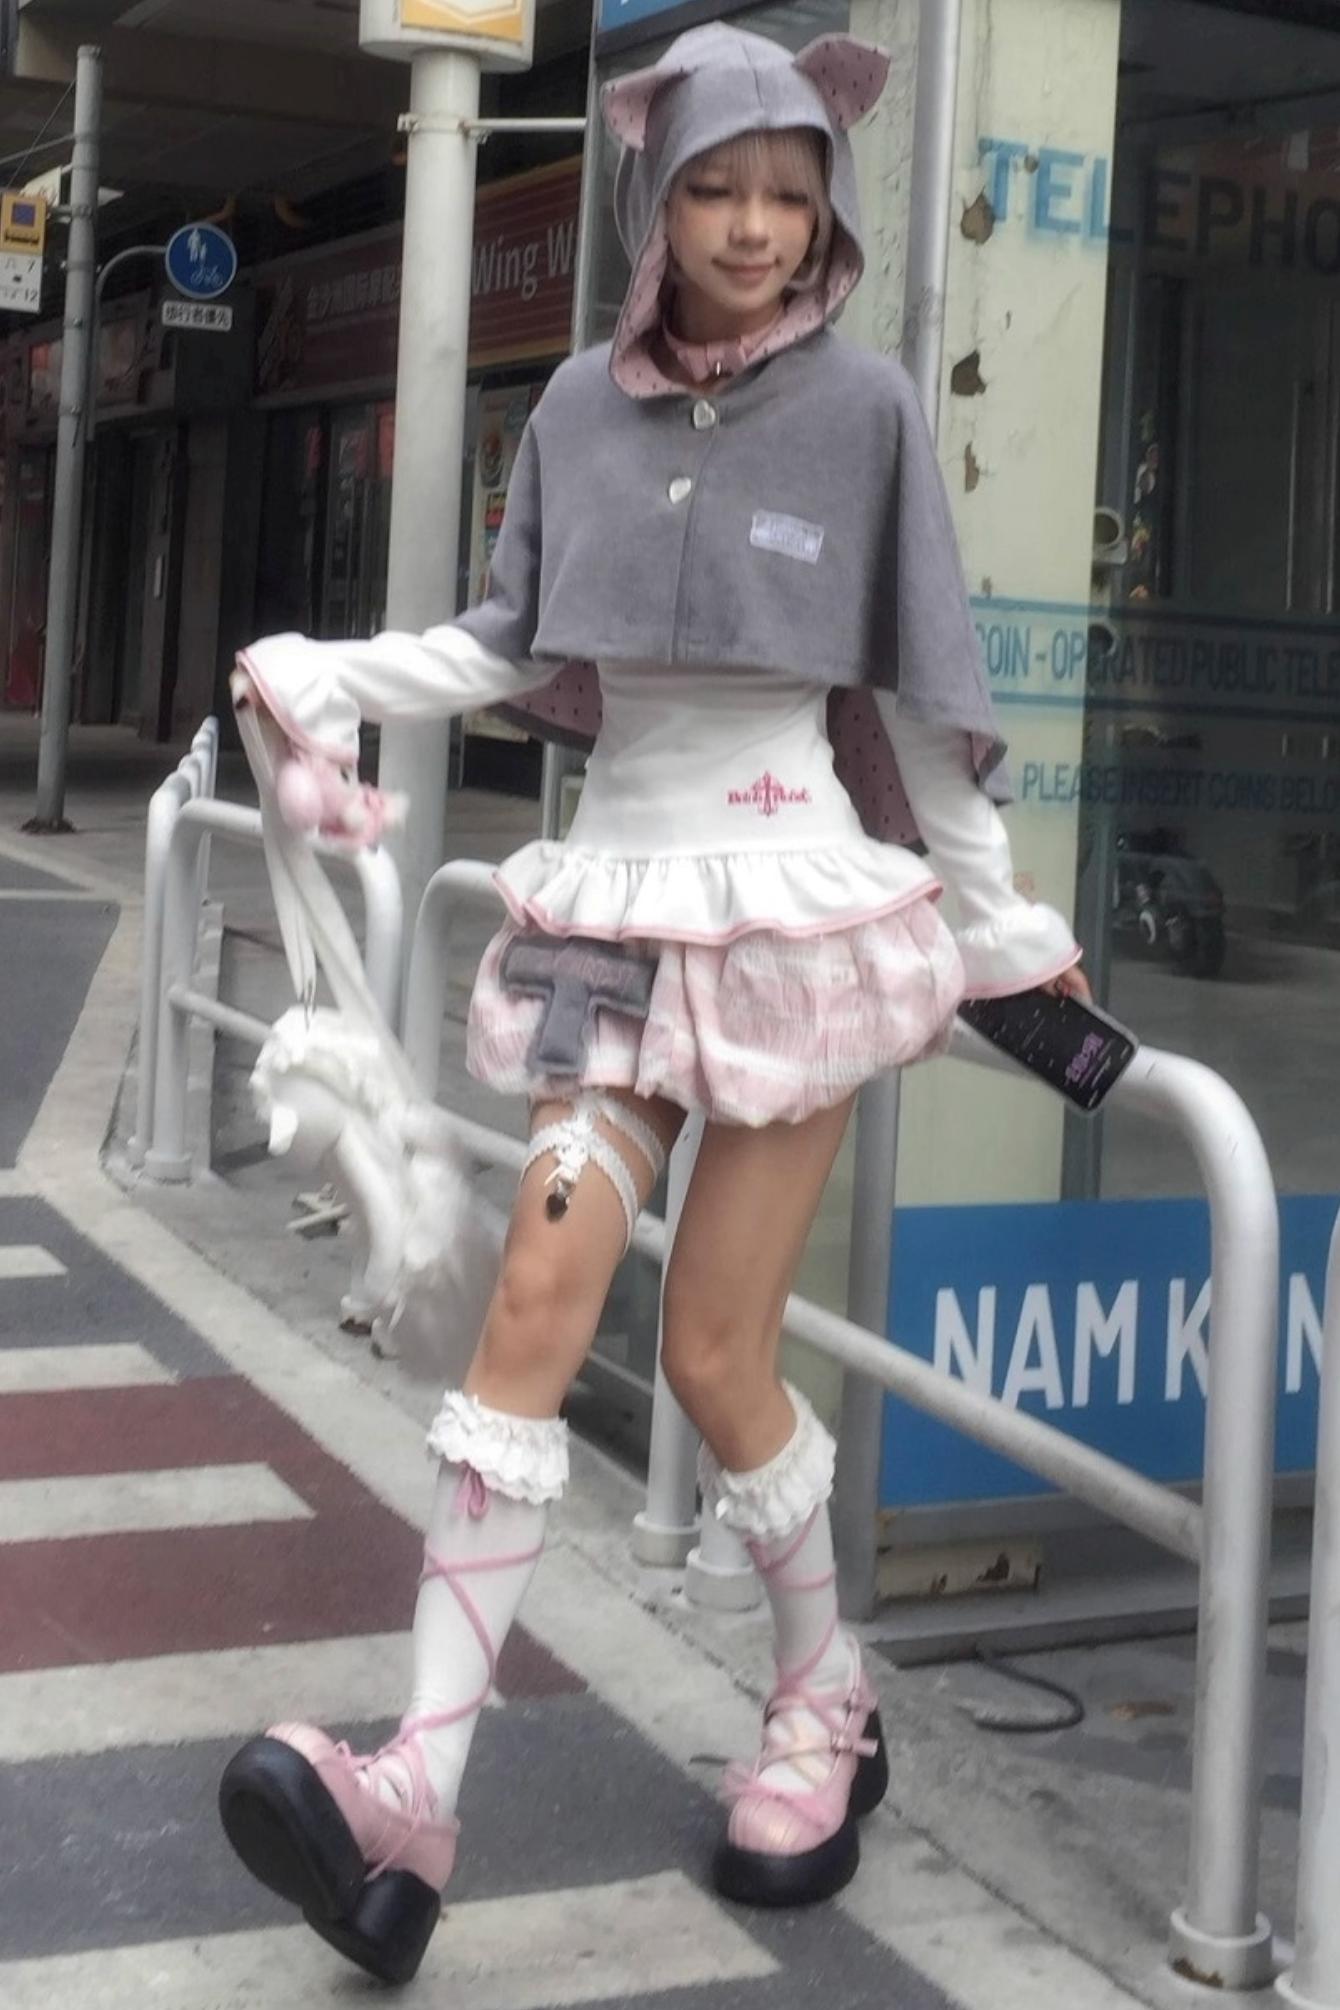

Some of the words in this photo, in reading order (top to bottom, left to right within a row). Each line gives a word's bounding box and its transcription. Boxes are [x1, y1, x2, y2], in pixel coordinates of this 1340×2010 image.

[472, 234, 539, 301] Wing
[1022, 762, 1119, 803] PLEASE
[1208, 772, 1277, 812] COINS
[934, 1280, 1139, 1409] NAM
